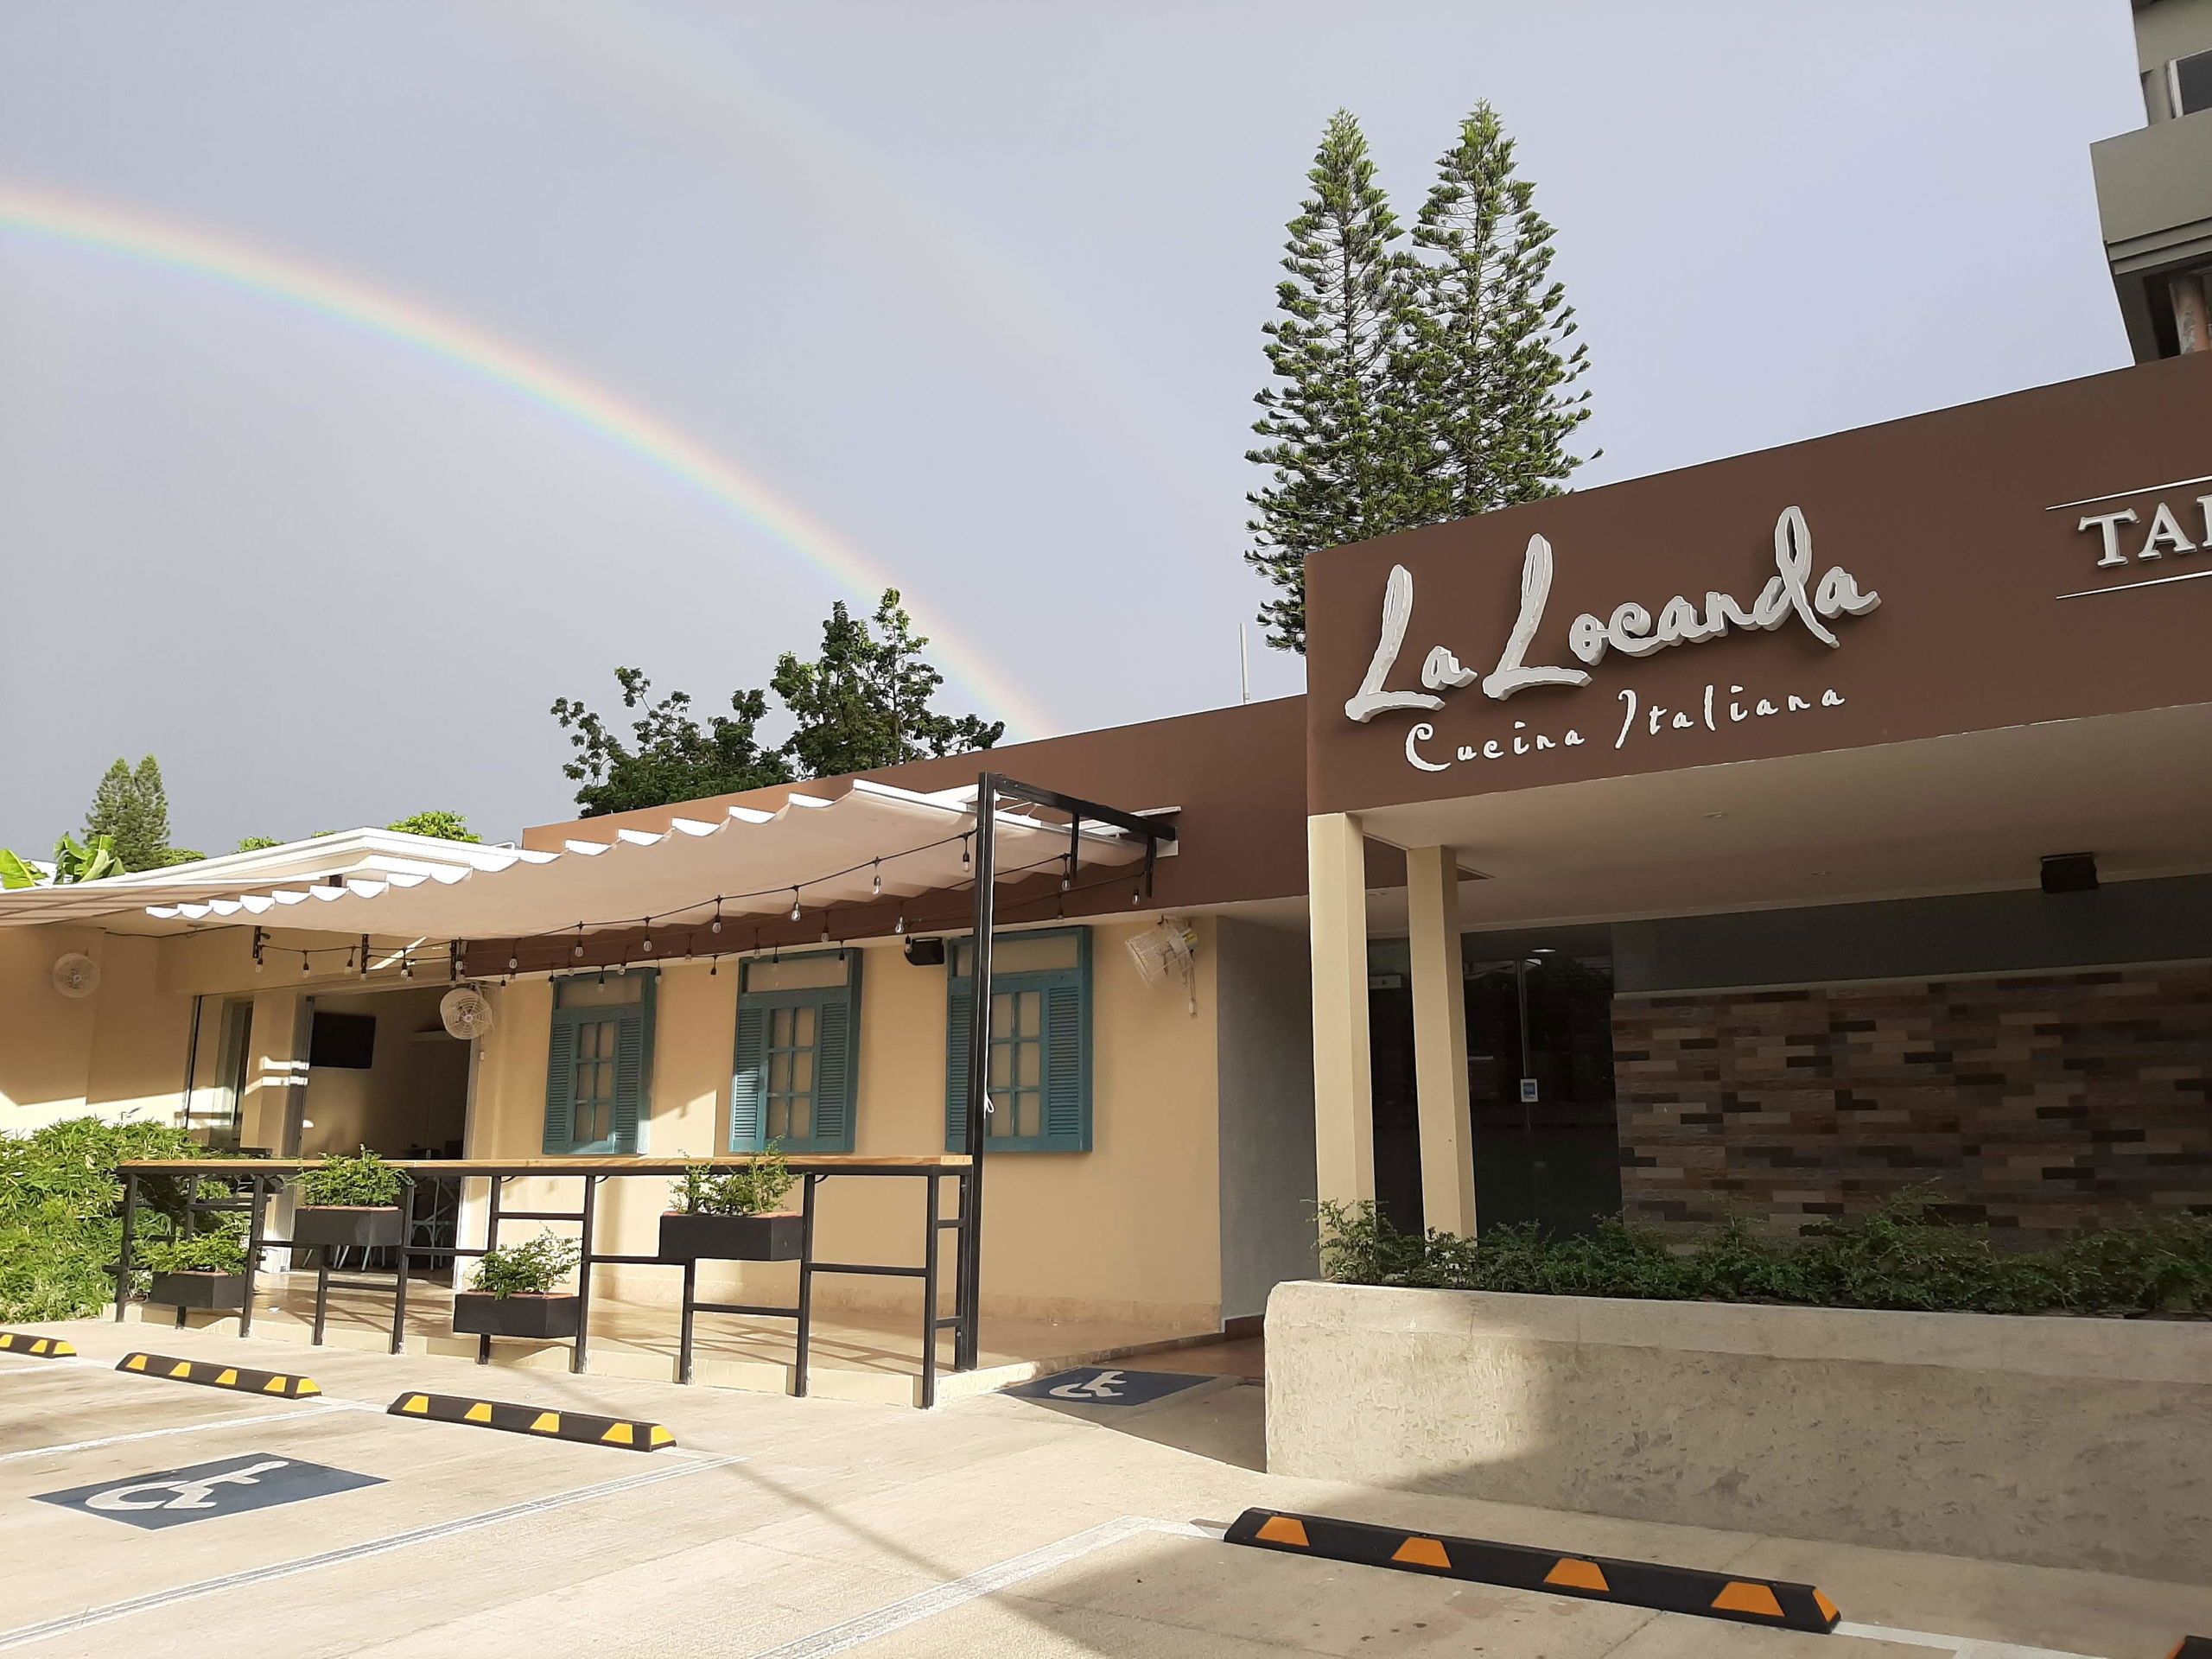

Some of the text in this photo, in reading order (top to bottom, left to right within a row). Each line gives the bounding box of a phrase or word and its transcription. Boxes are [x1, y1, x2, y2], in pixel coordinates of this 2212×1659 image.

[1344, 505, 1882, 723] La Locanda
[1405, 684, 1846, 772] Cucina Italiana
